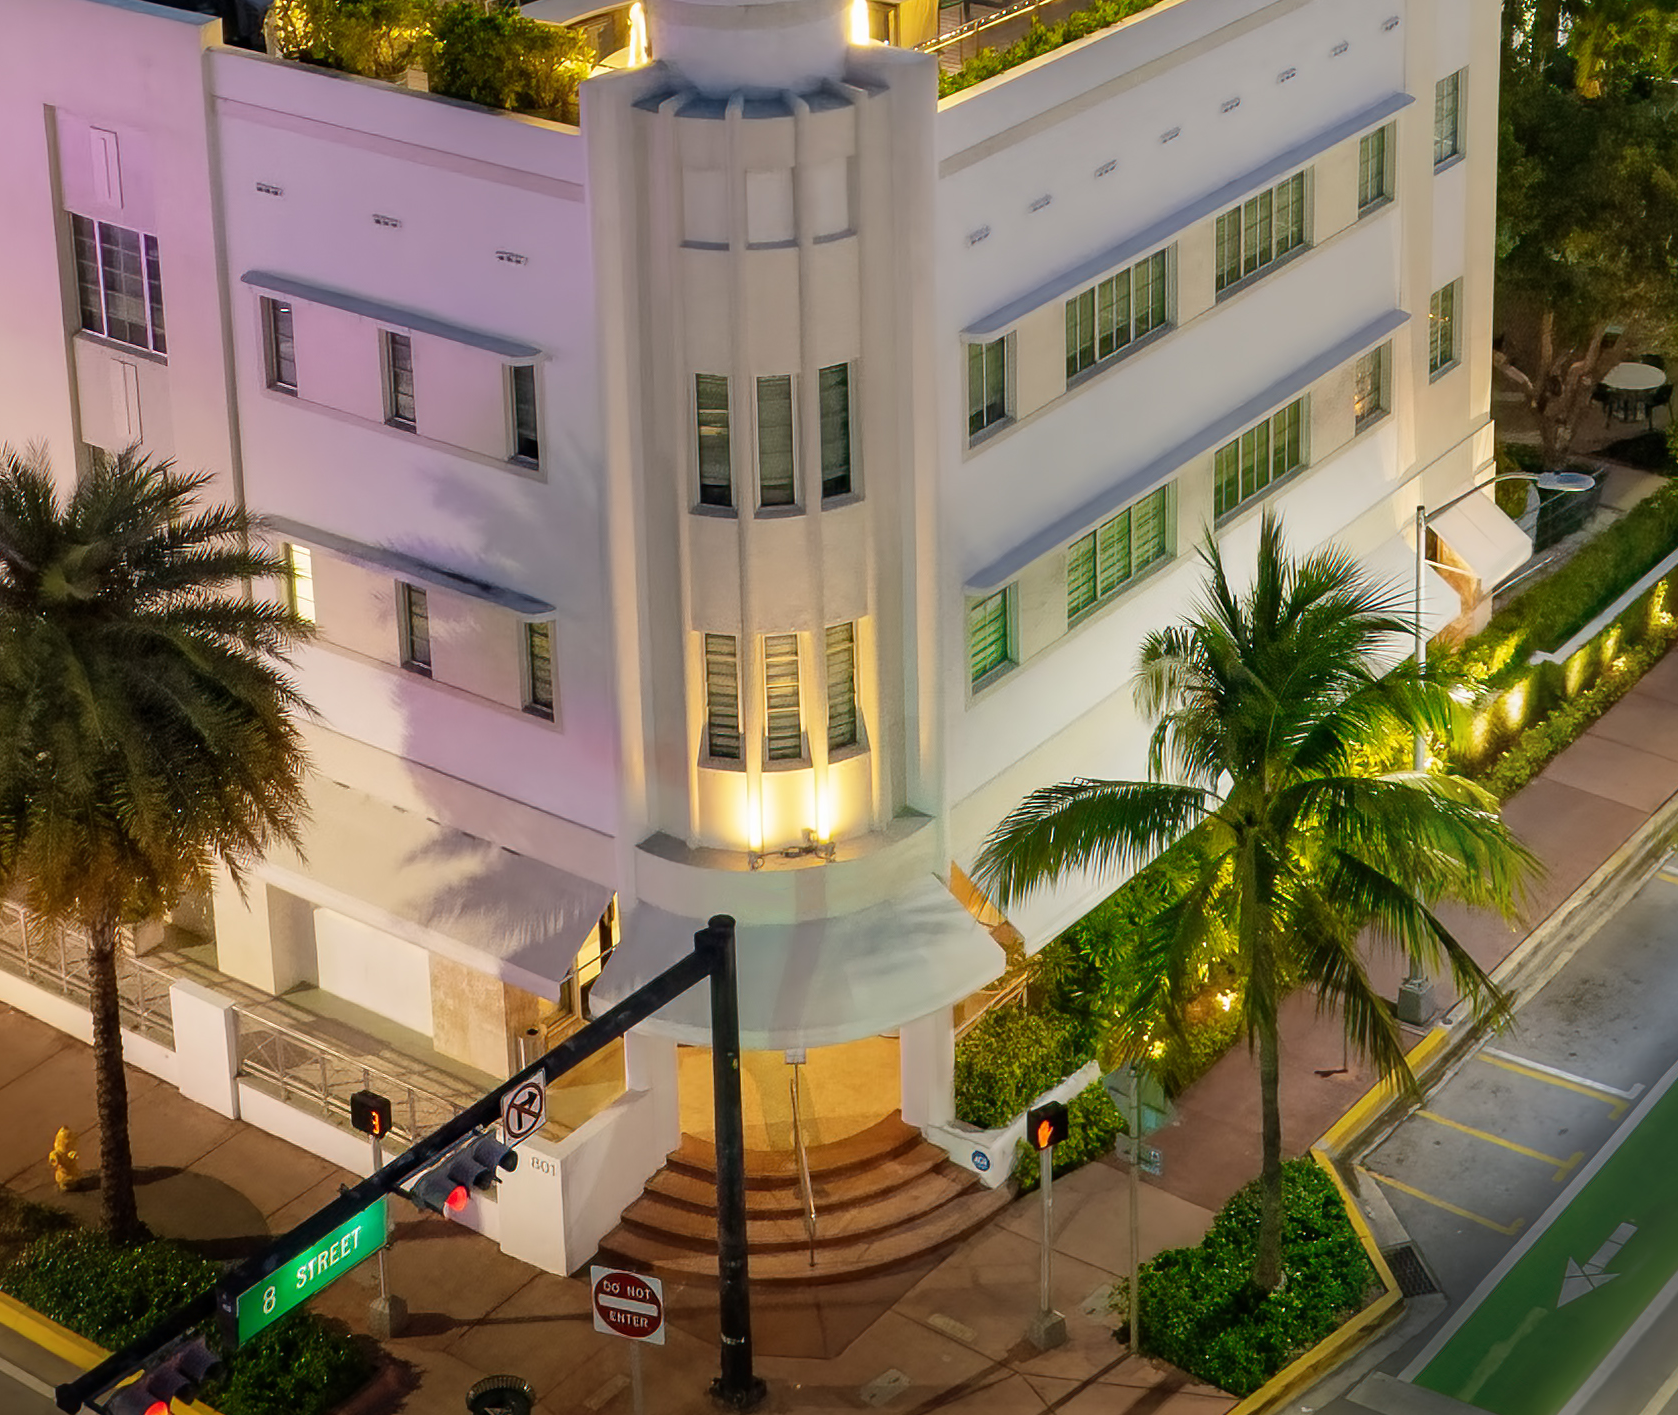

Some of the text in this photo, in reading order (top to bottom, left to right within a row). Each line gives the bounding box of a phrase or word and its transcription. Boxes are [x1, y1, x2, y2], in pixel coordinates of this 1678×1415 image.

[531, 1157, 555, 1176] 801
[263, 1226, 362, 1315] 8 STREET
[603, 1280, 651, 1301] DO NOT
[609, 1310, 649, 1328] ENTER
